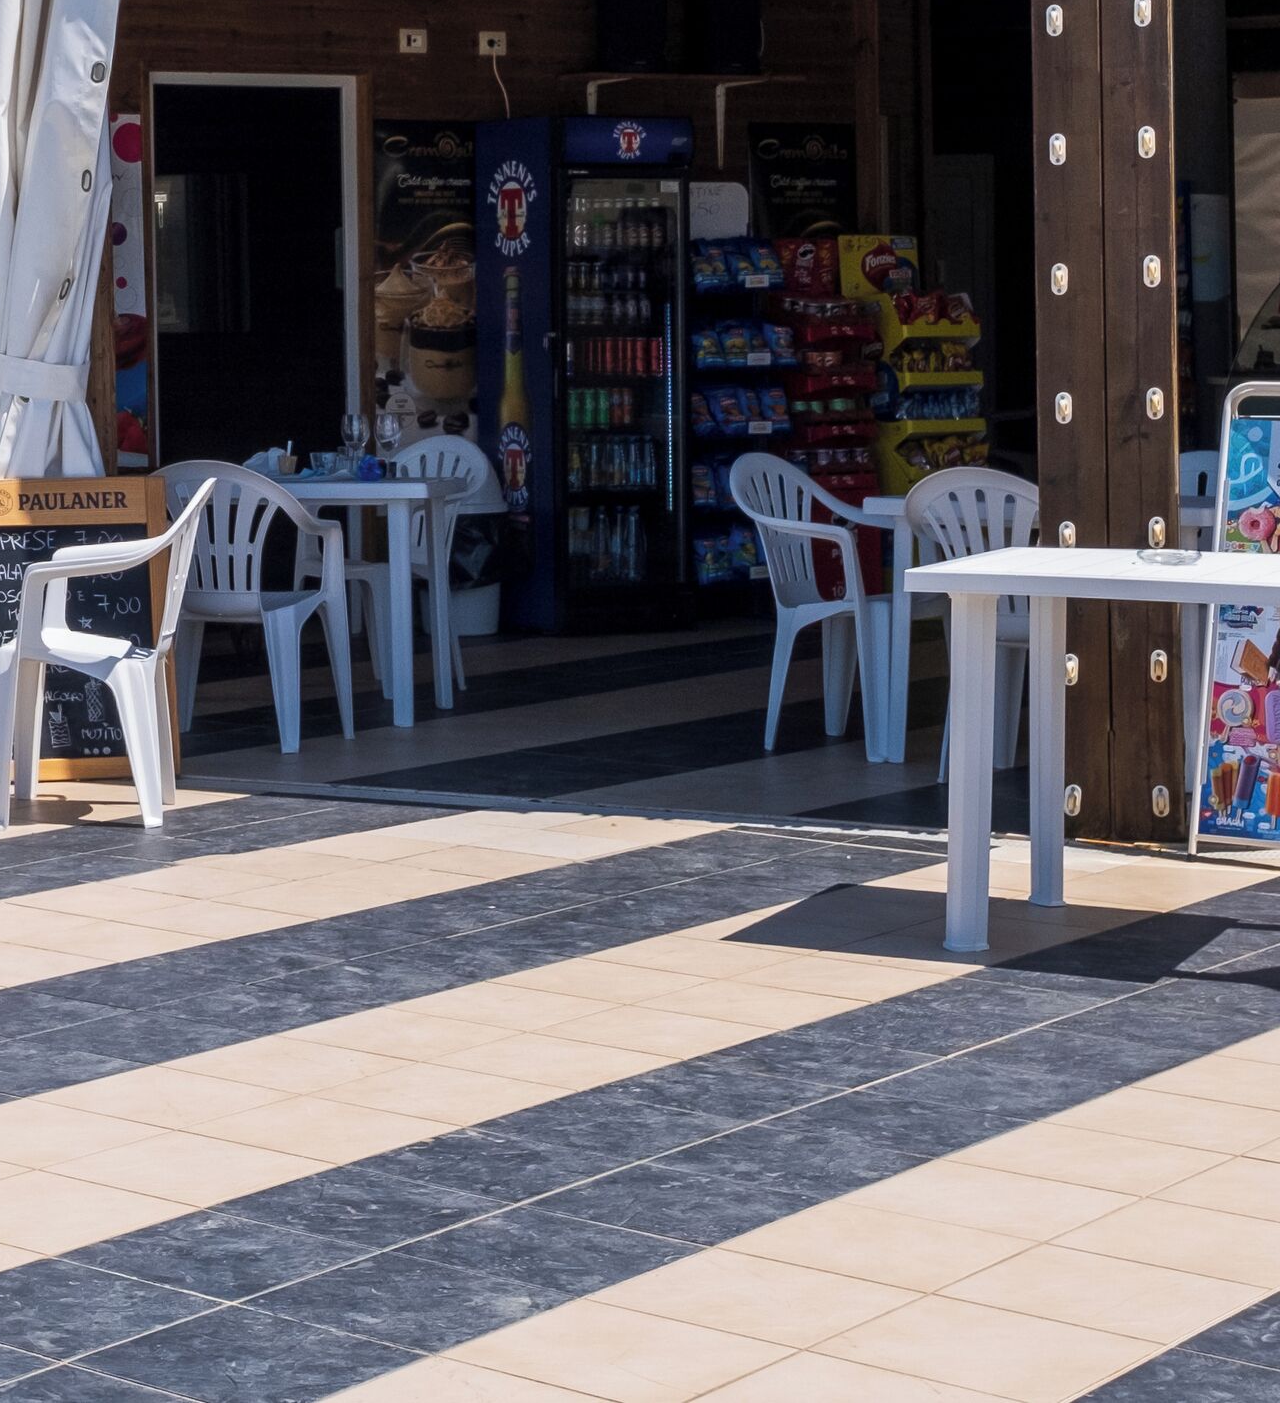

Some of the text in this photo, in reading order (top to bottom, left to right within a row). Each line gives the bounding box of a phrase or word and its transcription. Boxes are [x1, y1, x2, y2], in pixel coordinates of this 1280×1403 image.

[487, 160, 537, 204] TENNENT'S
[495, 231, 531, 258] SUPER
[18, 490, 129, 511] PAULANER
